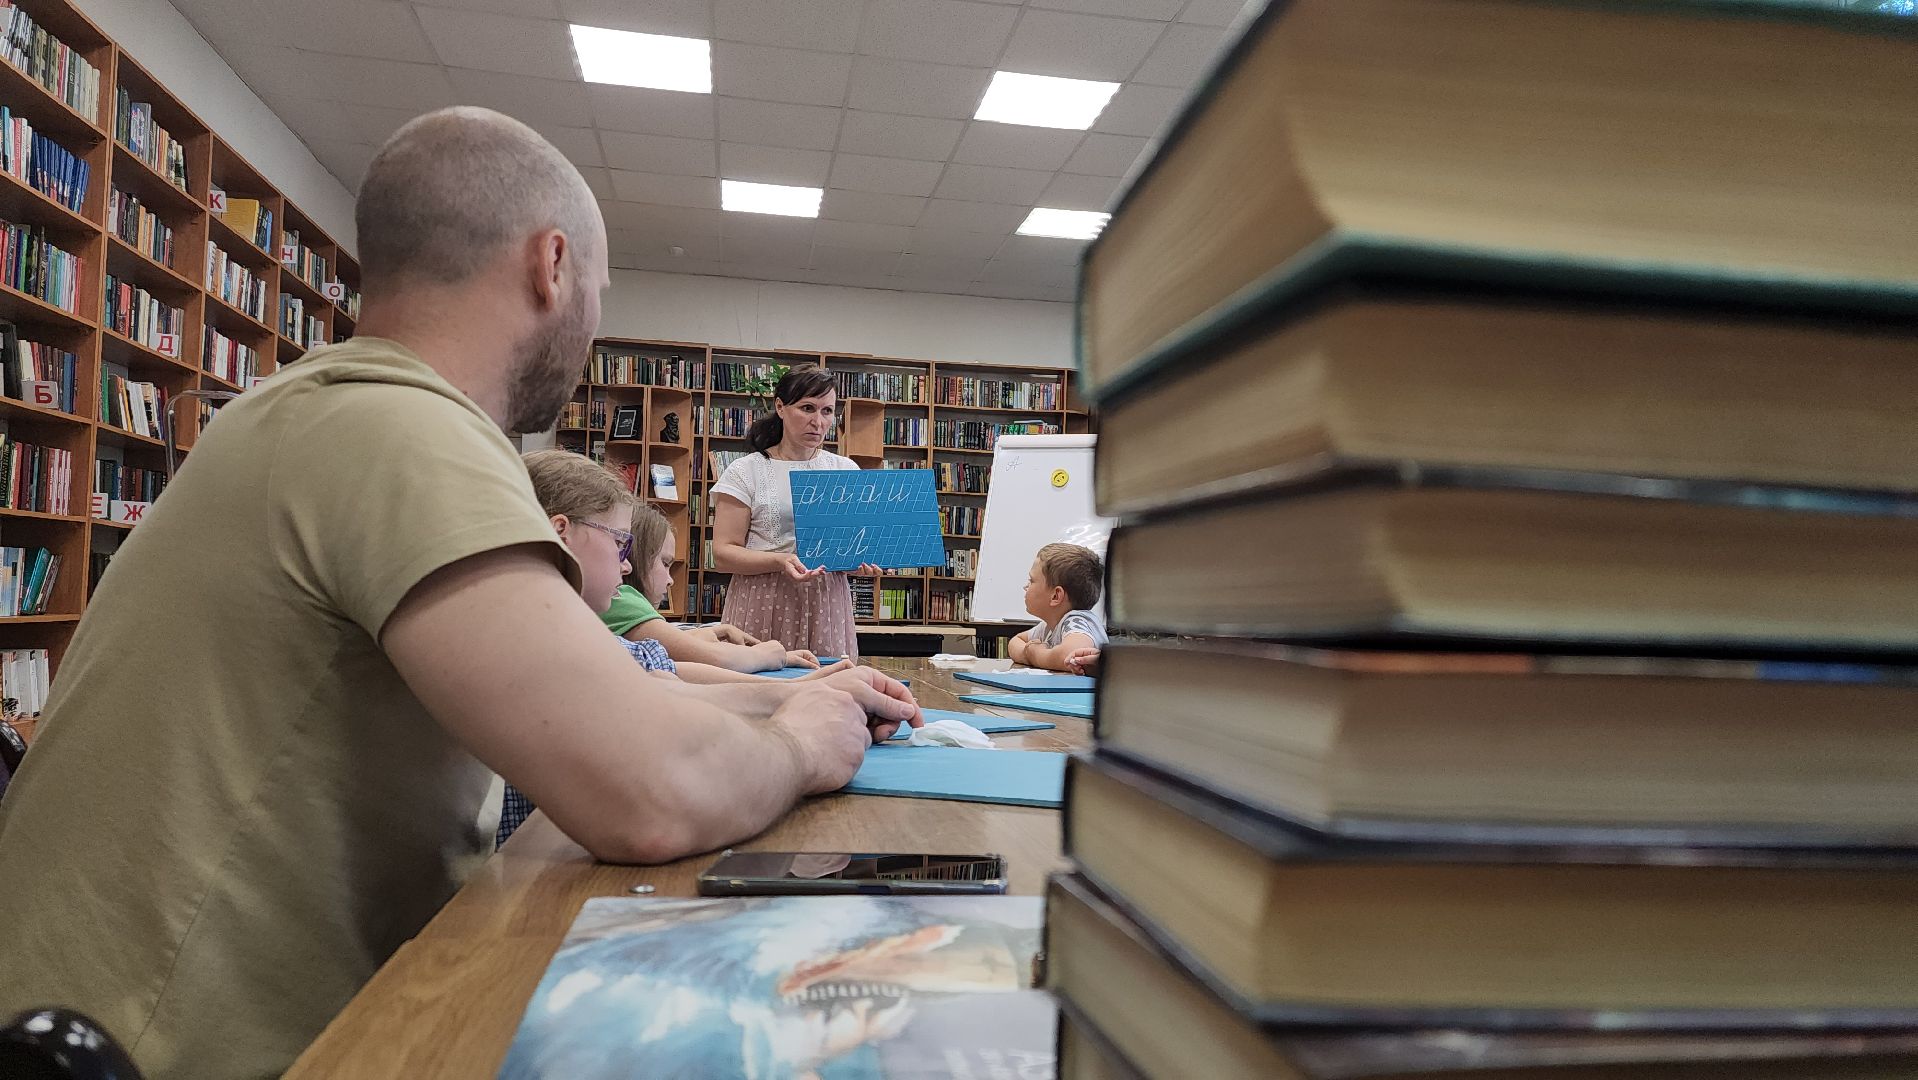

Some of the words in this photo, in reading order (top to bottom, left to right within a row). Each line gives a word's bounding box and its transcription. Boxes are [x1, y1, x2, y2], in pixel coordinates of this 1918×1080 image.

[209, 193, 222, 210] К
[281, 247, 293, 261] Н
[157, 335, 173, 354] Д
[35, 384, 53, 404] Б
[123, 503, 146, 521] Ж
